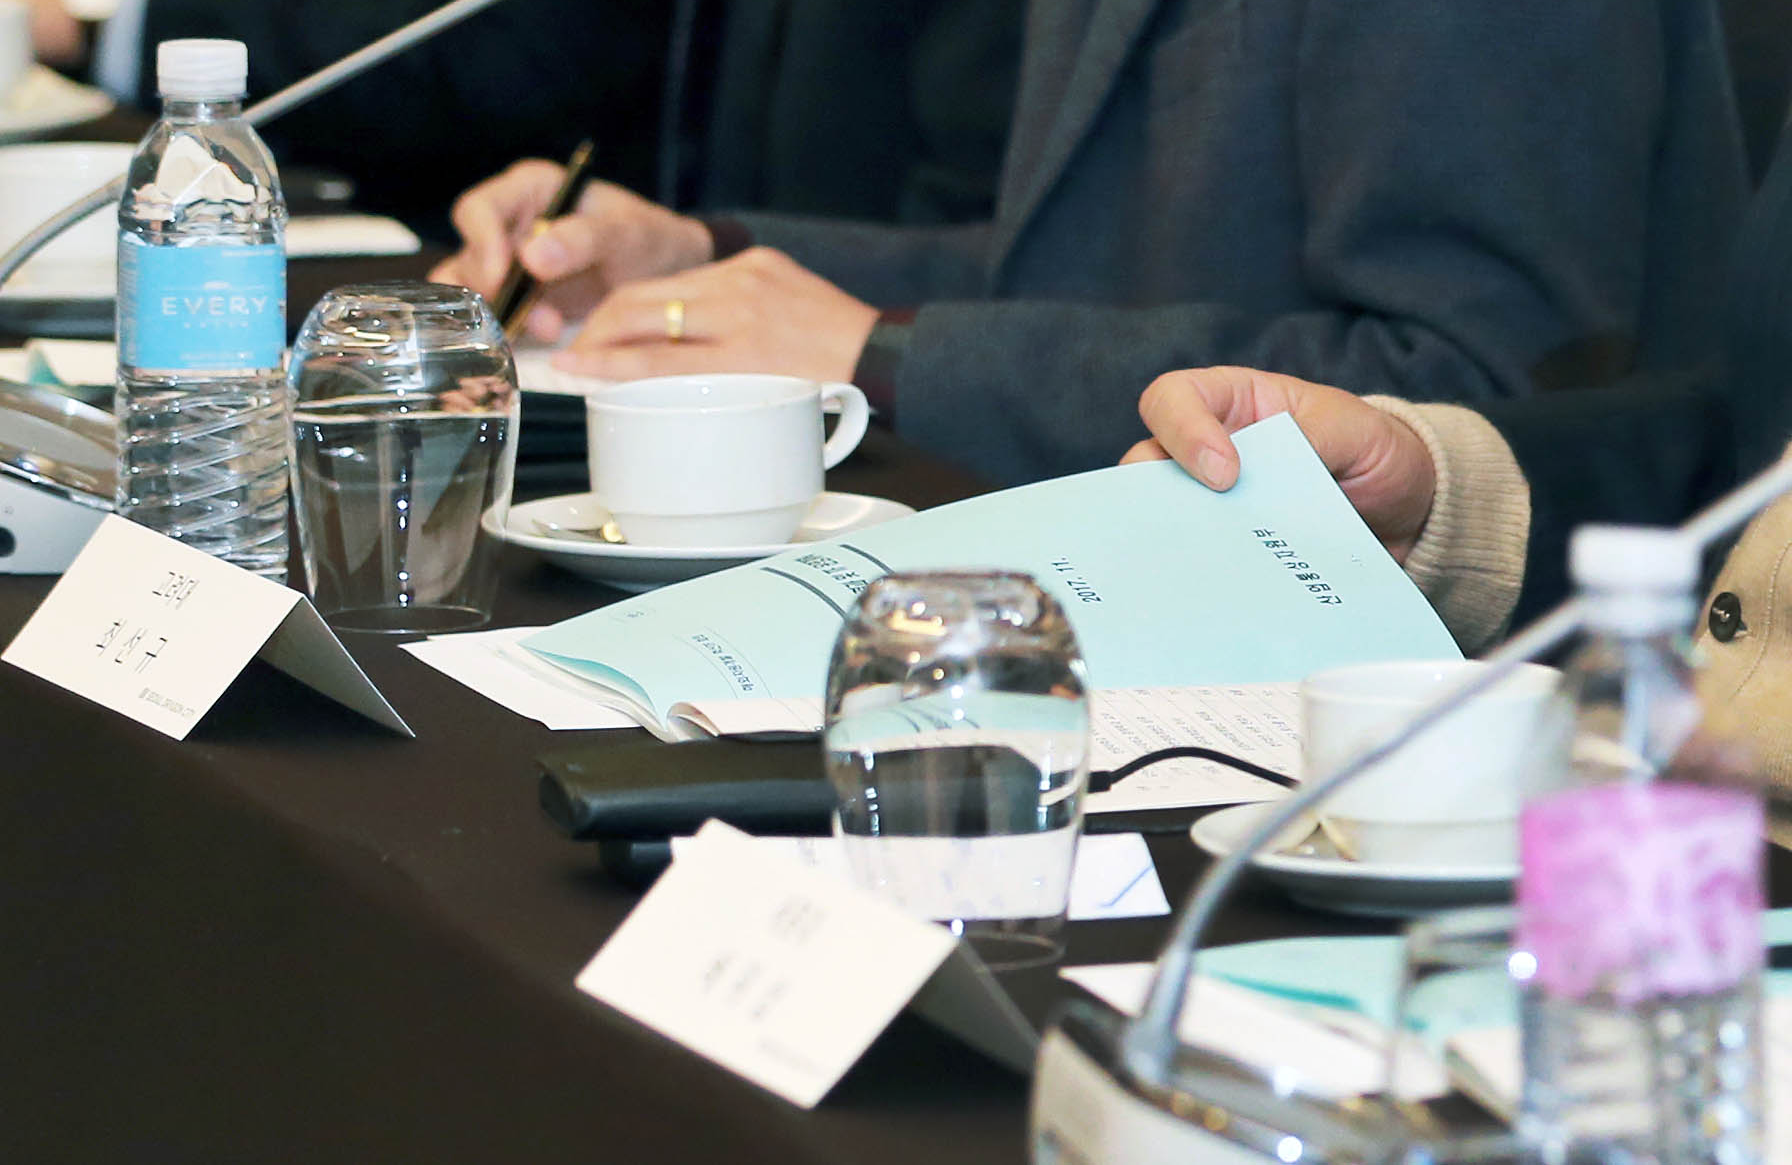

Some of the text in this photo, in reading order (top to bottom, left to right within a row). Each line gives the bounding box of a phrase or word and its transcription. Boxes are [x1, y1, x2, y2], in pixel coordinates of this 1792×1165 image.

[161, 296, 269, 316] EVERY
[1051, 557, 1102, 602] 2017. 11.
[1252, 529, 1343, 605] 산업통상자원부
